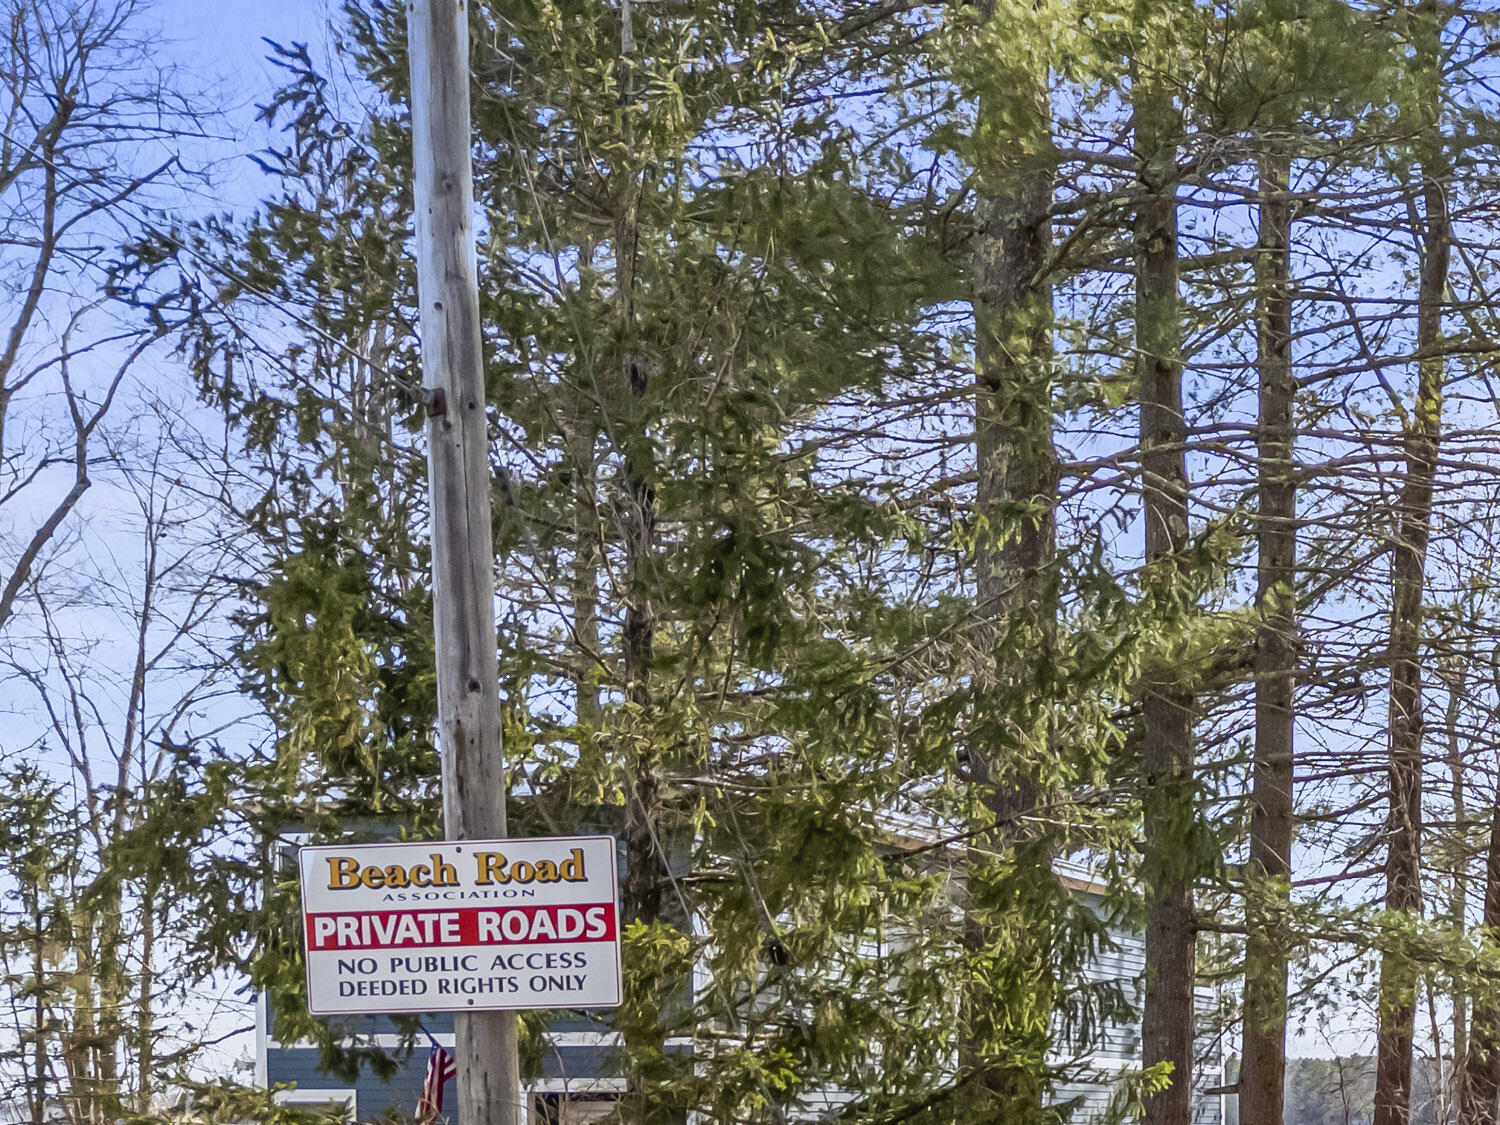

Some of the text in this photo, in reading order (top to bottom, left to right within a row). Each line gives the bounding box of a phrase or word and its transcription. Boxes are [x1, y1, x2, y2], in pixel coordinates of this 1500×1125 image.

[325, 848, 588, 891] Beach Road
[382, 888, 536, 902] ASSOCIATION
[313, 906, 608, 947] PRIVATE ROADS
[337, 951, 587, 975] NO PUBLIC ACCESS
[338, 974, 588, 997] DEEDED RIGHTS ONLY
